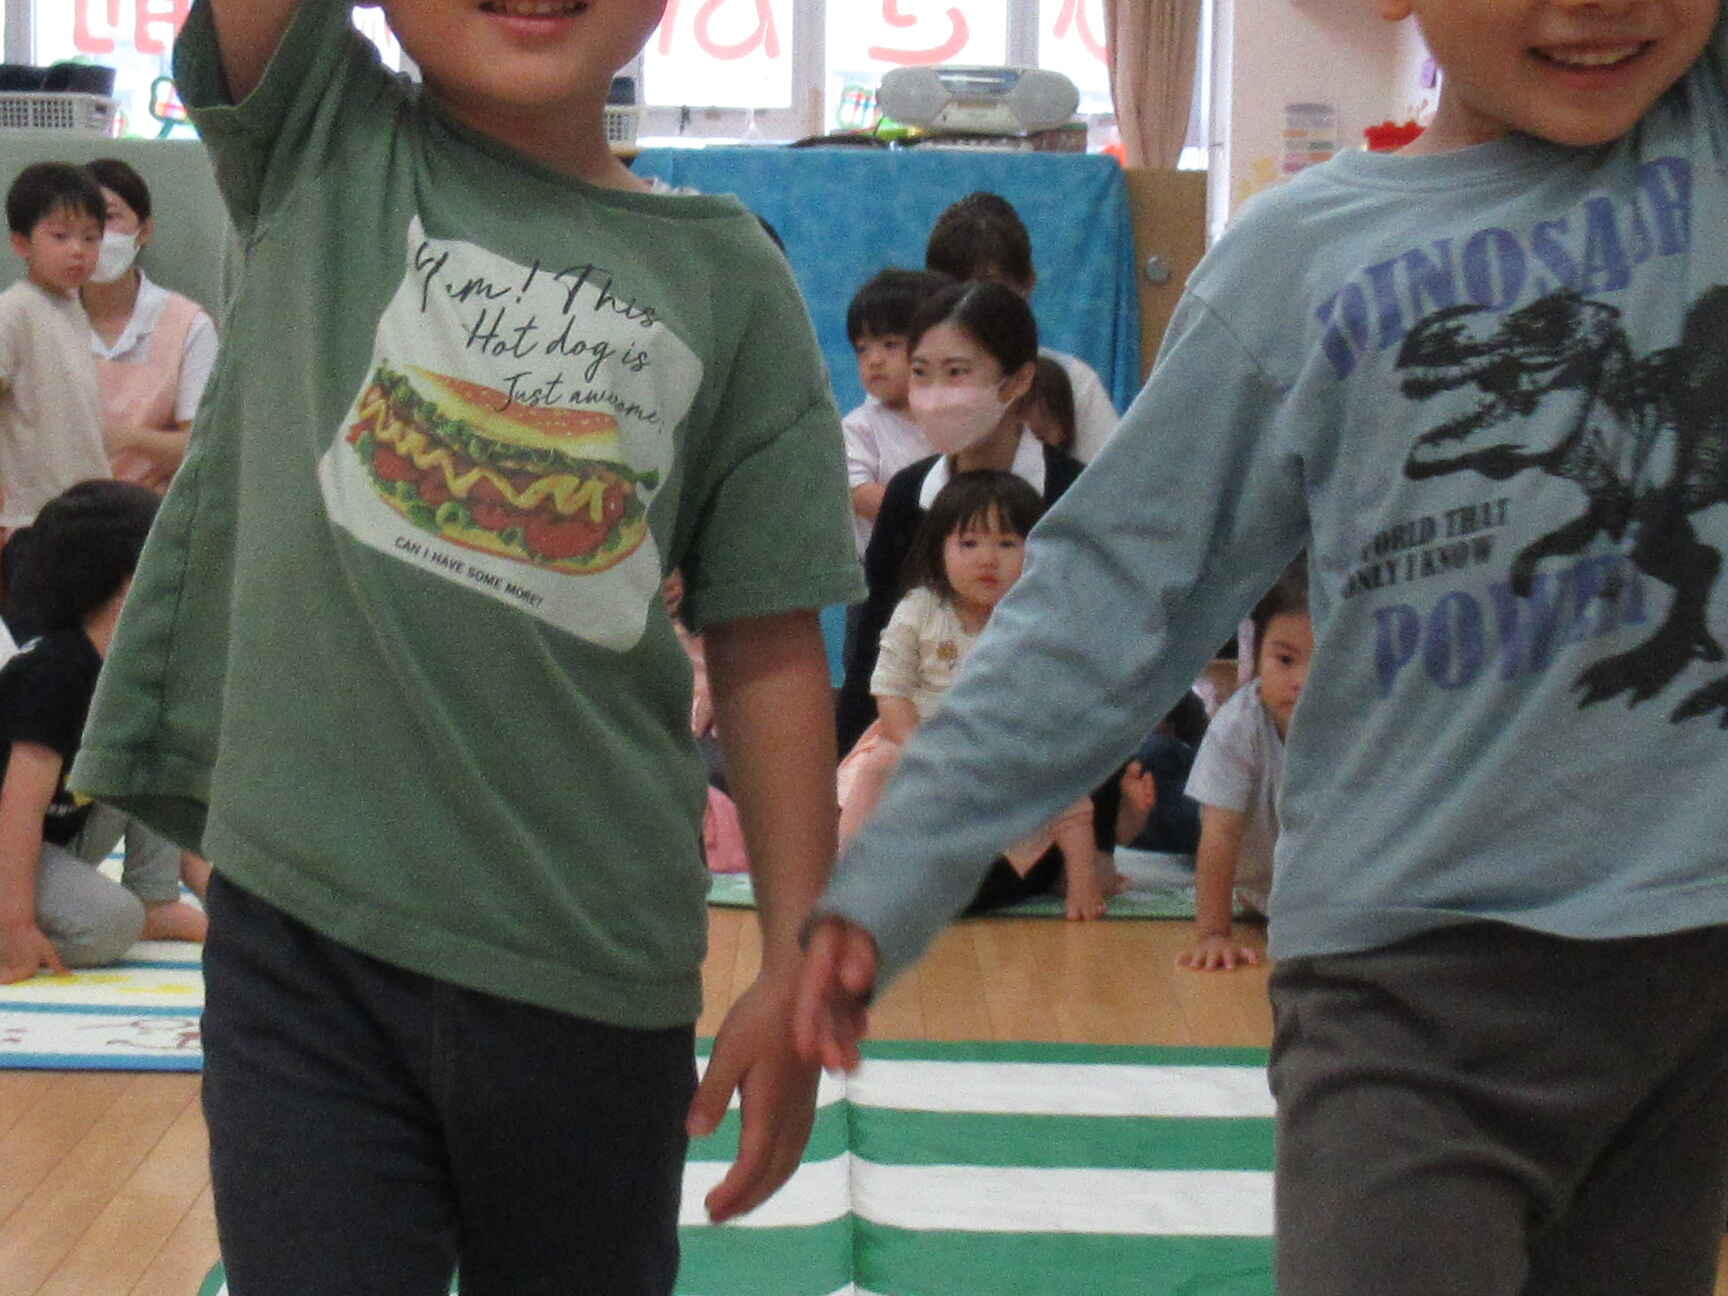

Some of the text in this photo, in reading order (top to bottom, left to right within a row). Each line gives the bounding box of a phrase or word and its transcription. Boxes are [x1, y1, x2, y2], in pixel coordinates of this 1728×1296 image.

[553, 262, 660, 328] This
[465, 305, 652, 382] Hot dog is
[493, 371, 563, 413] Just
[394, 535, 422, 556] CAN
[431, 551, 466, 574] HAVE
[467, 565, 505, 588] SOME
